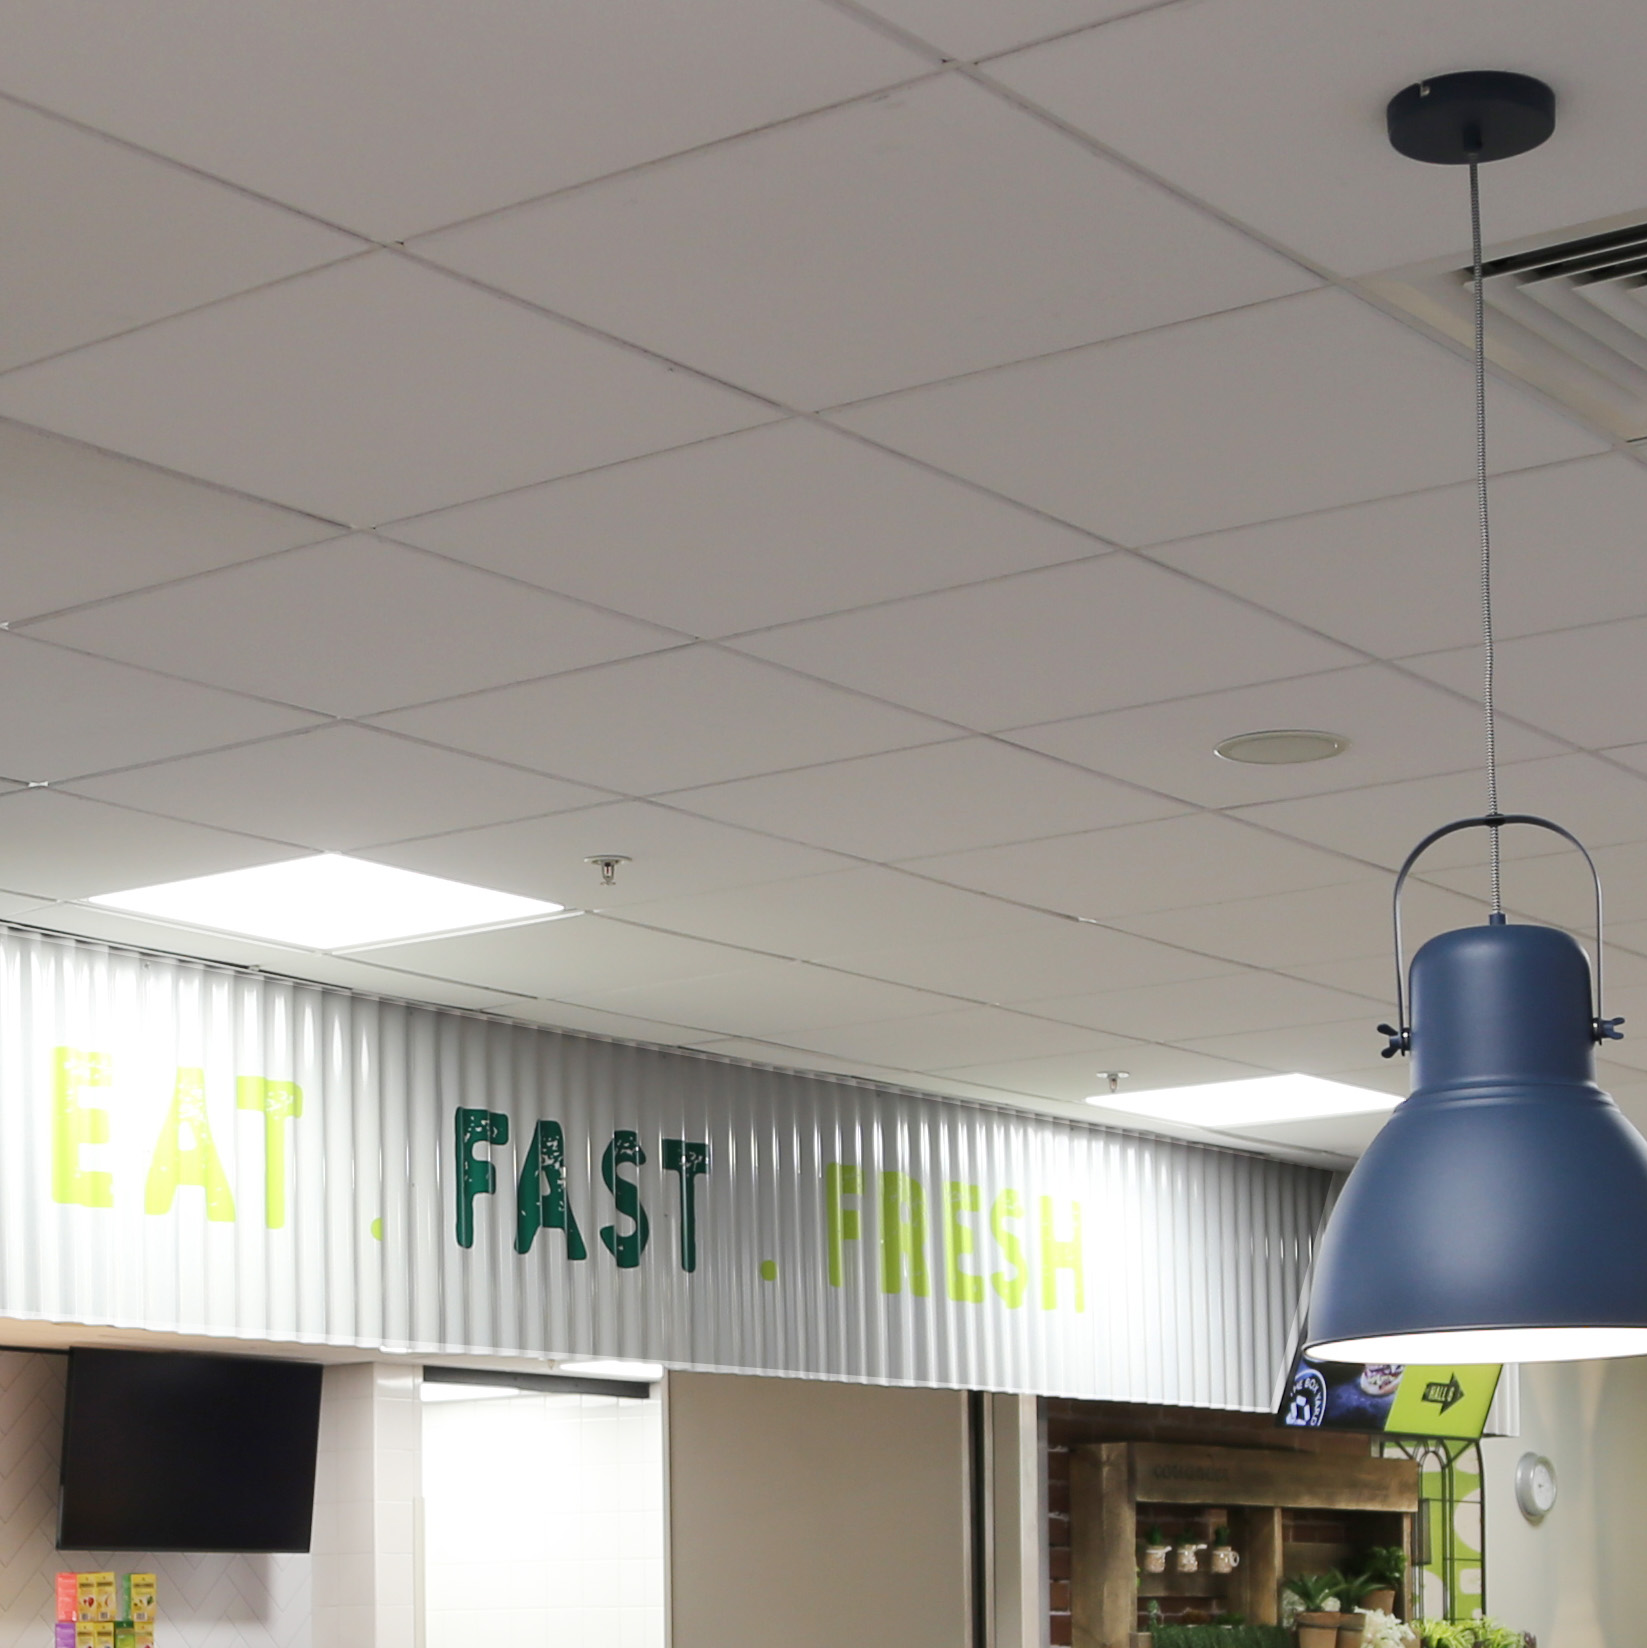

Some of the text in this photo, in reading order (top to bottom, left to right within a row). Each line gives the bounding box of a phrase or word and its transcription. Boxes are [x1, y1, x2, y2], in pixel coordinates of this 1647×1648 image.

[52, 1046, 1085, 1313] EAT FAST FRESH
